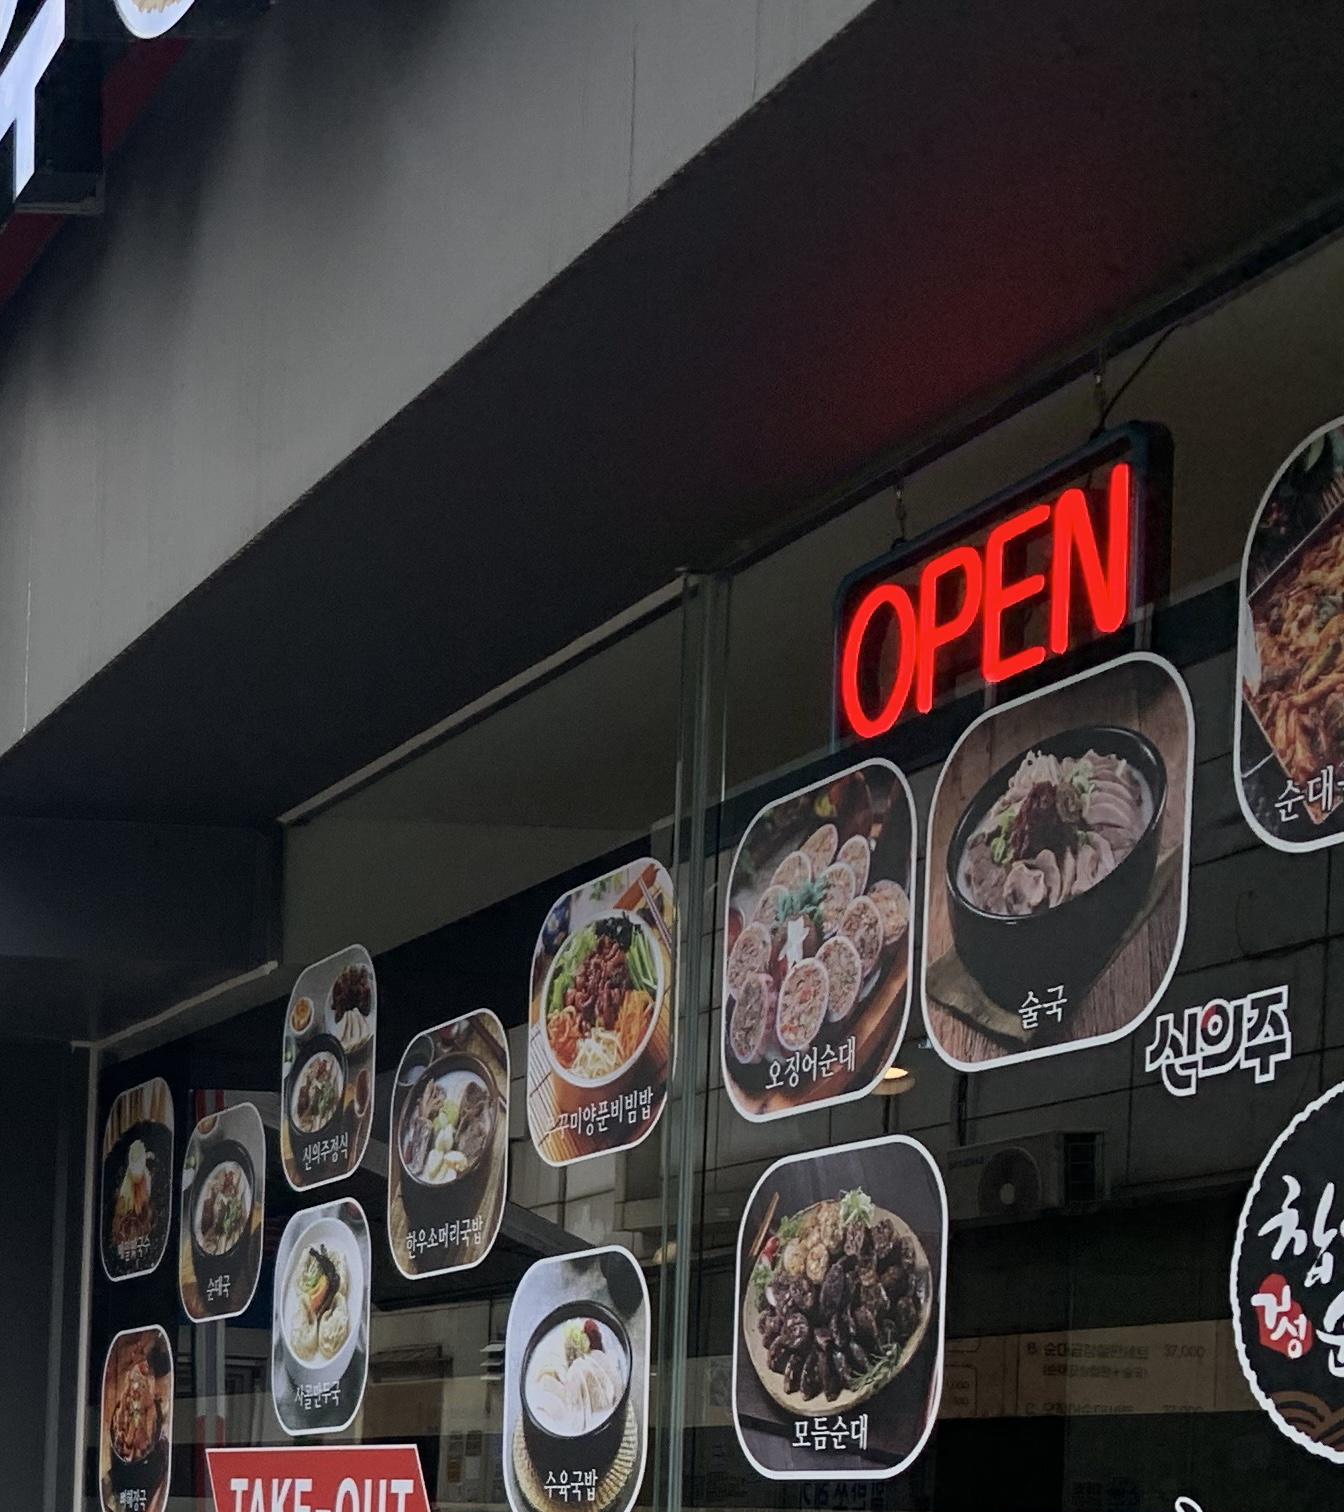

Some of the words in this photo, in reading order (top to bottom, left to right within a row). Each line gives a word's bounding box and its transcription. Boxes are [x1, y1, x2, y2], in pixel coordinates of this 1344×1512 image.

[842, 463, 1131, 739] OPEN
[1274, 764, 1344, 823] 순대
[1019, 985, 1068, 1029] 술국
[765, 1036, 856, 1090] 오징어순대
[1145, 985, 1292, 1096] 신의주
[542, 1086, 654, 1140] 꾸미양푼비빔밥
[302, 1132, 349, 1171] 신의주정식
[406, 1215, 485, 1260] 한우소머리국밥
[206, 1275, 231, 1301] 순대국
[792, 1414, 870, 1450] 모듬순대
[544, 1470, 599, 1498] 수육국밥
